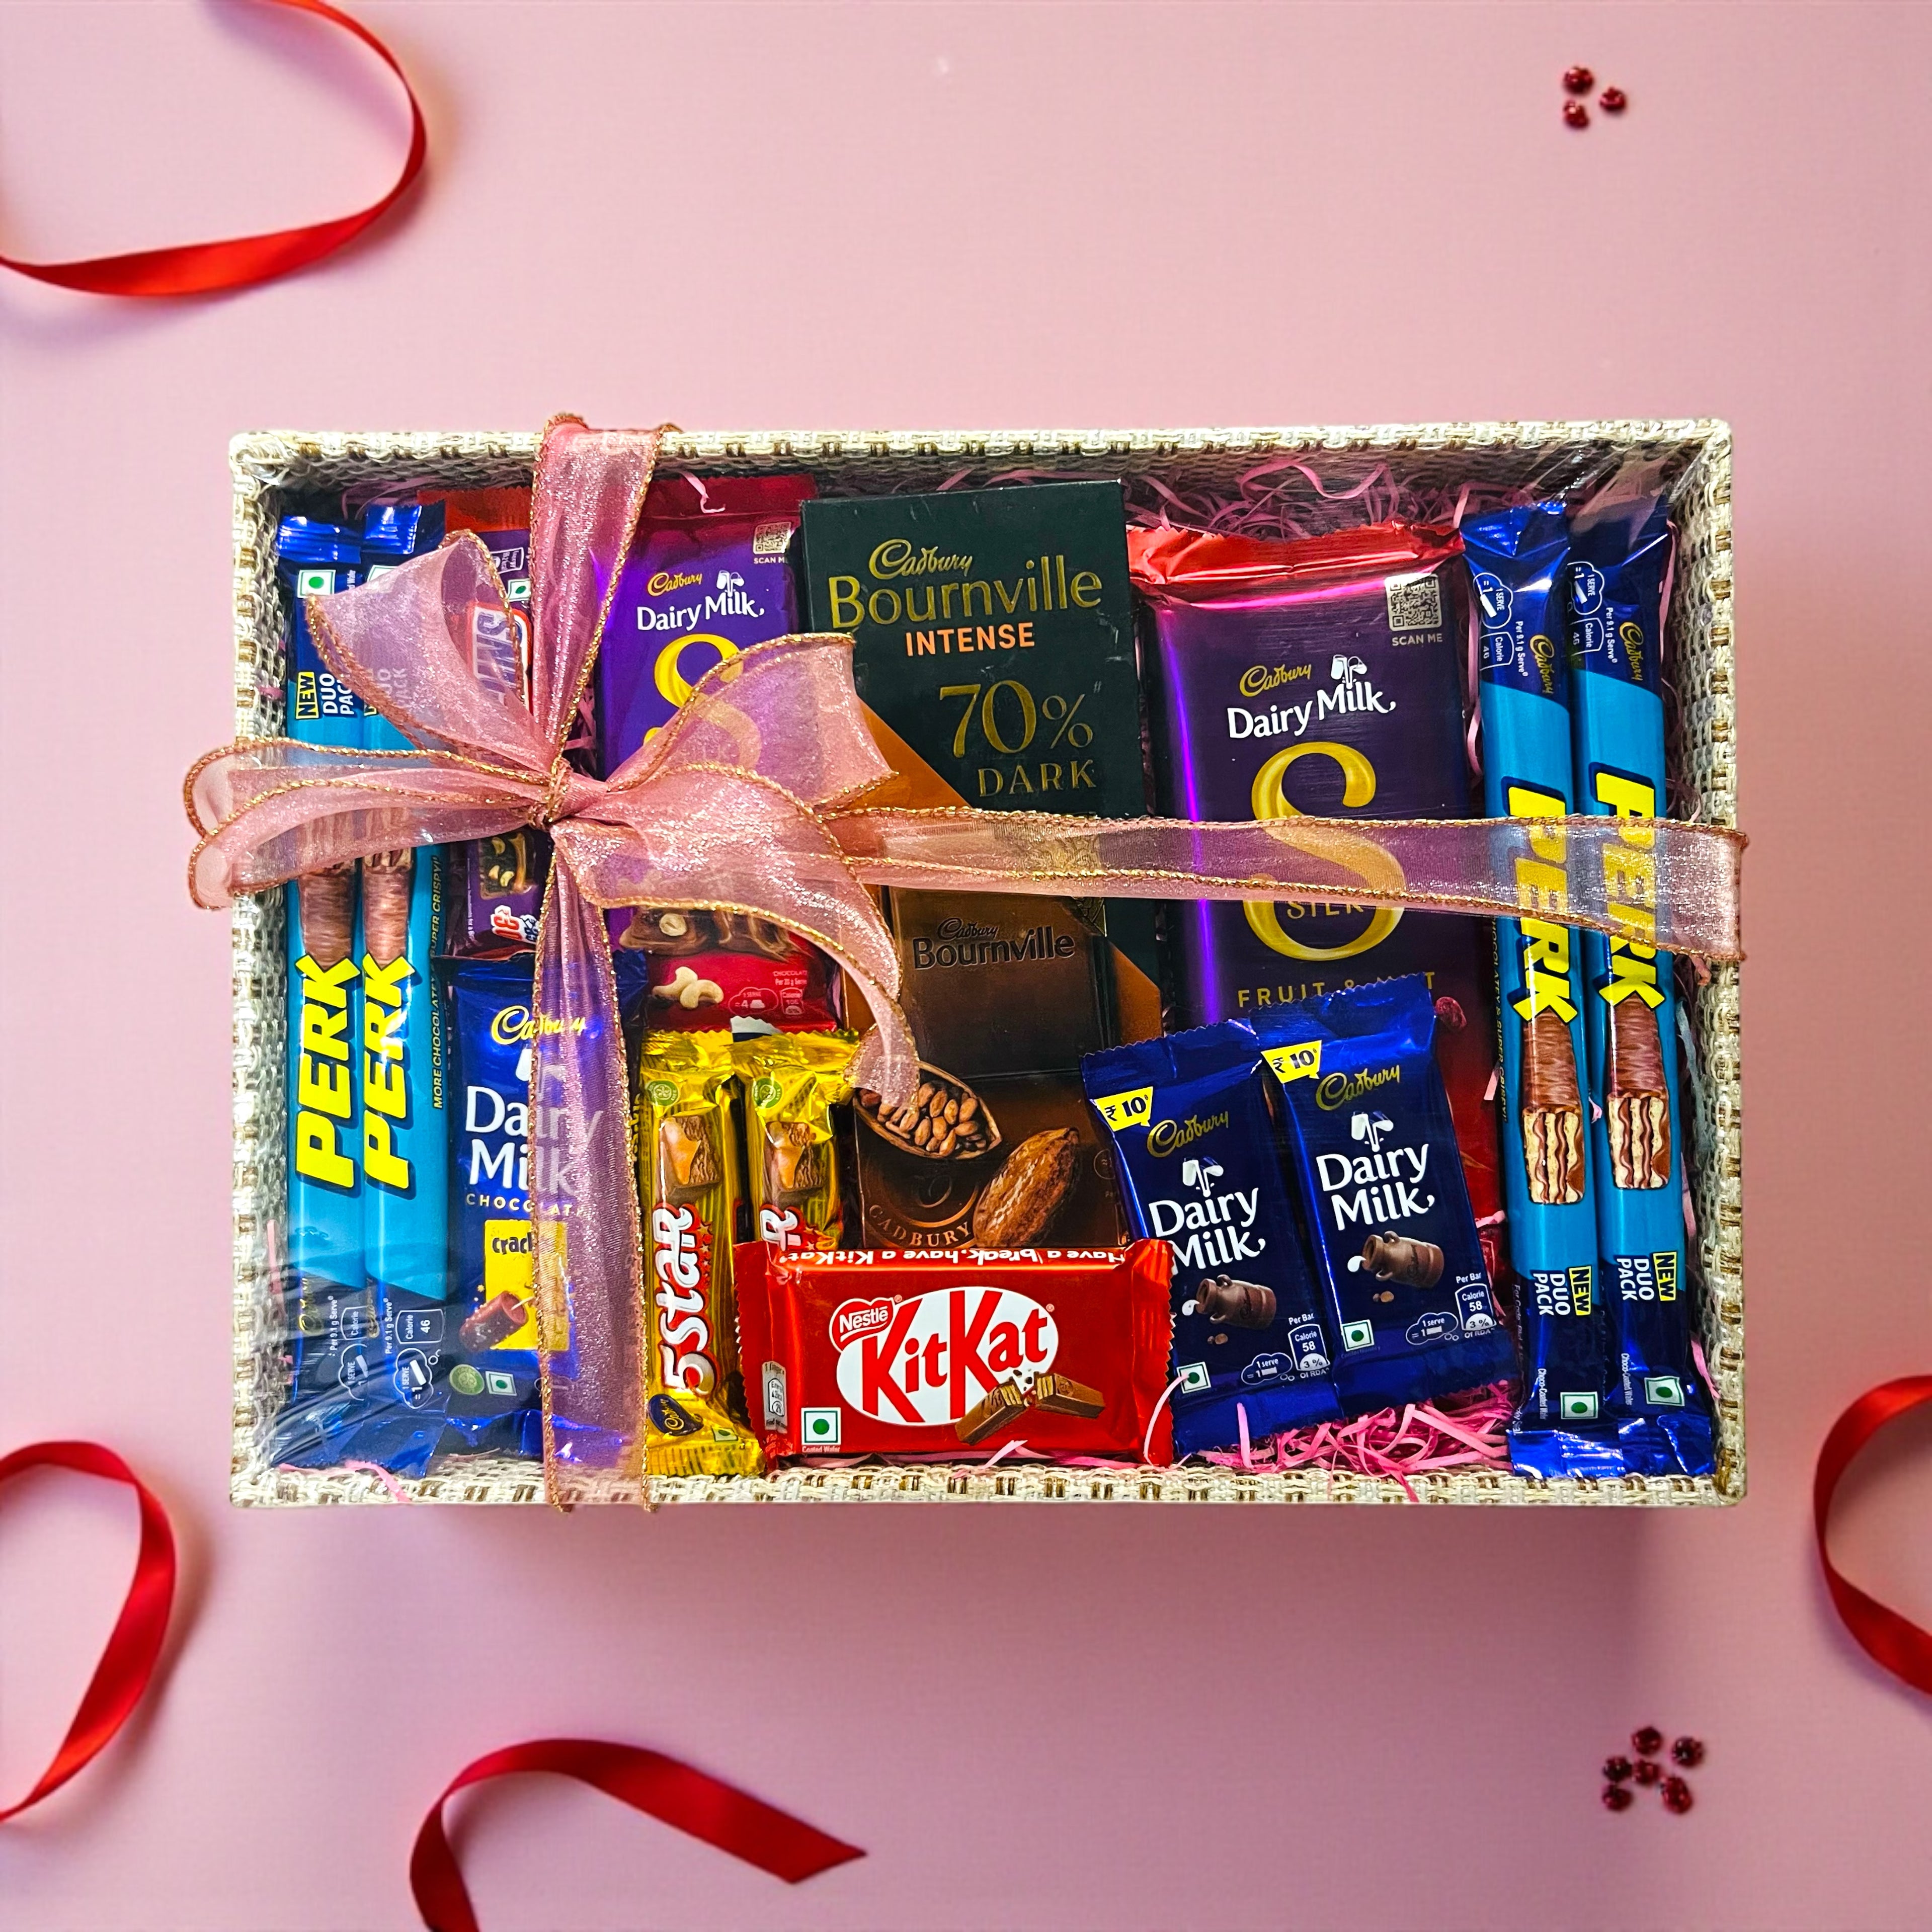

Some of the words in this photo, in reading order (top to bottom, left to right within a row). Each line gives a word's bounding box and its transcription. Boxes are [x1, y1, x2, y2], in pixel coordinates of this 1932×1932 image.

[868, 538, 973, 580] Cadbury
[648, 572, 702, 596] Cadbury
[828, 554, 1102, 628] Bournville
[1496, 592, 1505, 611] SERVE
[1587, 578, 1596, 597] SERVE
[637, 603, 702, 631] Dairy
[705, 592, 765, 620] Milk
[1515, 621, 1524, 633] Per
[1605, 607, 1614, 620] Per
[906, 622, 1035, 657] INTENSE
[1392, 634, 1424, 647] SCAN
[1427, 633, 1443, 643] ME
[1495, 636, 1504, 662] Calorie
[1585, 622, 1593, 648] Calorie
[1619, 621, 1644, 681] Cadbury
[1239, 664, 1312, 697] Cadbury
[1530, 634, 1556, 694] Cadbury
[298, 675, 316, 716] NEW
[319, 673, 338, 714] DUO
[336, 679, 355, 714] PAC
[1227, 700, 1313, 739] Dairy
[1317, 681, 1396, 721] Milk
[940, 680, 1093, 758] 70%
[978, 759, 1096, 797] DARK
[1508, 786, 1578, 1023] PERK
[1595, 772, 1665, 1009] PERK
[912, 926, 1075, 970] Bournville
[937, 917, 999, 941] Cadbury
[1238, 982, 1325, 1007] FRUIT
[295, 954, 360, 1189] PERK
[363, 953, 415, 1189] PERK
[433, 1067, 443, 1109] MORE
[1316, 1065, 1401, 1111] Cadbury
[1147, 1111, 1229, 1158] Cadbury
[1316, 1143, 1430, 1192] Dairy
[869, 1204, 972, 1247] CADBURY
[1149, 1187, 1259, 1238] Dairy
[1332, 1182, 1436, 1231] Milk
[881, 1250, 897, 1259] a
[903, 1250, 958, 1264] have
[1047, 1250, 1062, 1259] a
[1067, 1250, 1125, 1263] Have
[1171, 1226, 1266, 1274] Milk
[1456, 1275, 1469, 1284] Per
[1470, 1272, 1482, 1281] Bar
[1462, 1290, 1485, 1302] Calorie
[1533, 1273, 1555, 1316] PACK
[1550, 1273, 1571, 1315] DUO
[1571, 1269, 1590, 1315] NEW
[1617, 1258, 1639, 1302] PACK
[1634, 1258, 1655, 1301] DUO
[1655, 1253, 1676, 1301] NEW
[351, 1311, 359, 1336] Calorie
[1289, 1317, 1301, 1325] Per
[1302, 1313, 1315, 1322] Bar
[1427, 1318, 1445, 1327] serve
[1469, 1301, 1483, 1312] 58
[406, 1314, 414, 1339] Calorie
[421, 1319, 431, 1334] 46
[1295, 1331, 1317, 1342] Calorie
[862, 1290, 1048, 1424] KitKat
[1261, 1358, 1279, 1367] serve
[1302, 1341, 1316, 1352] 58
[801, 1445, 823, 1454] Coated
